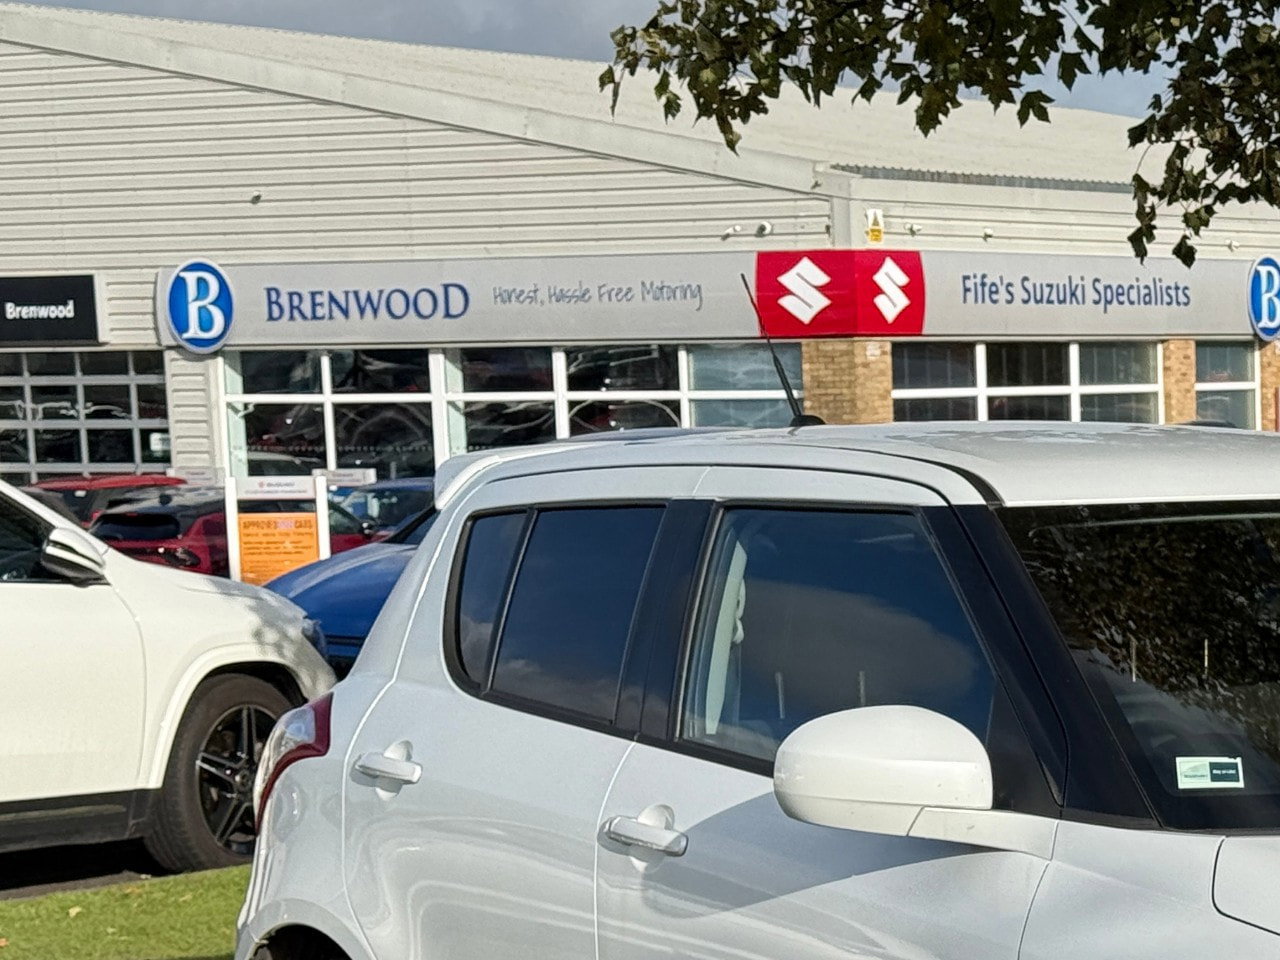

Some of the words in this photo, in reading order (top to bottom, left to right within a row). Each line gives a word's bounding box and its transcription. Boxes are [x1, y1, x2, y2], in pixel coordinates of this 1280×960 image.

[5, 300, 75, 319] Brenwood
[179, 270, 225, 339] B
[264, 283, 470, 321] BRENWOOD
[493, 283, 544, 306] Honest,
[547, 281, 592, 304] Hassle
[597, 283, 635, 304] Free
[640, 280, 703, 311] Motoring
[961, 273, 1015, 305] Fife's
[1020, 275, 1086, 306] Suzuki
[1091, 277, 1191, 313] Specialists
